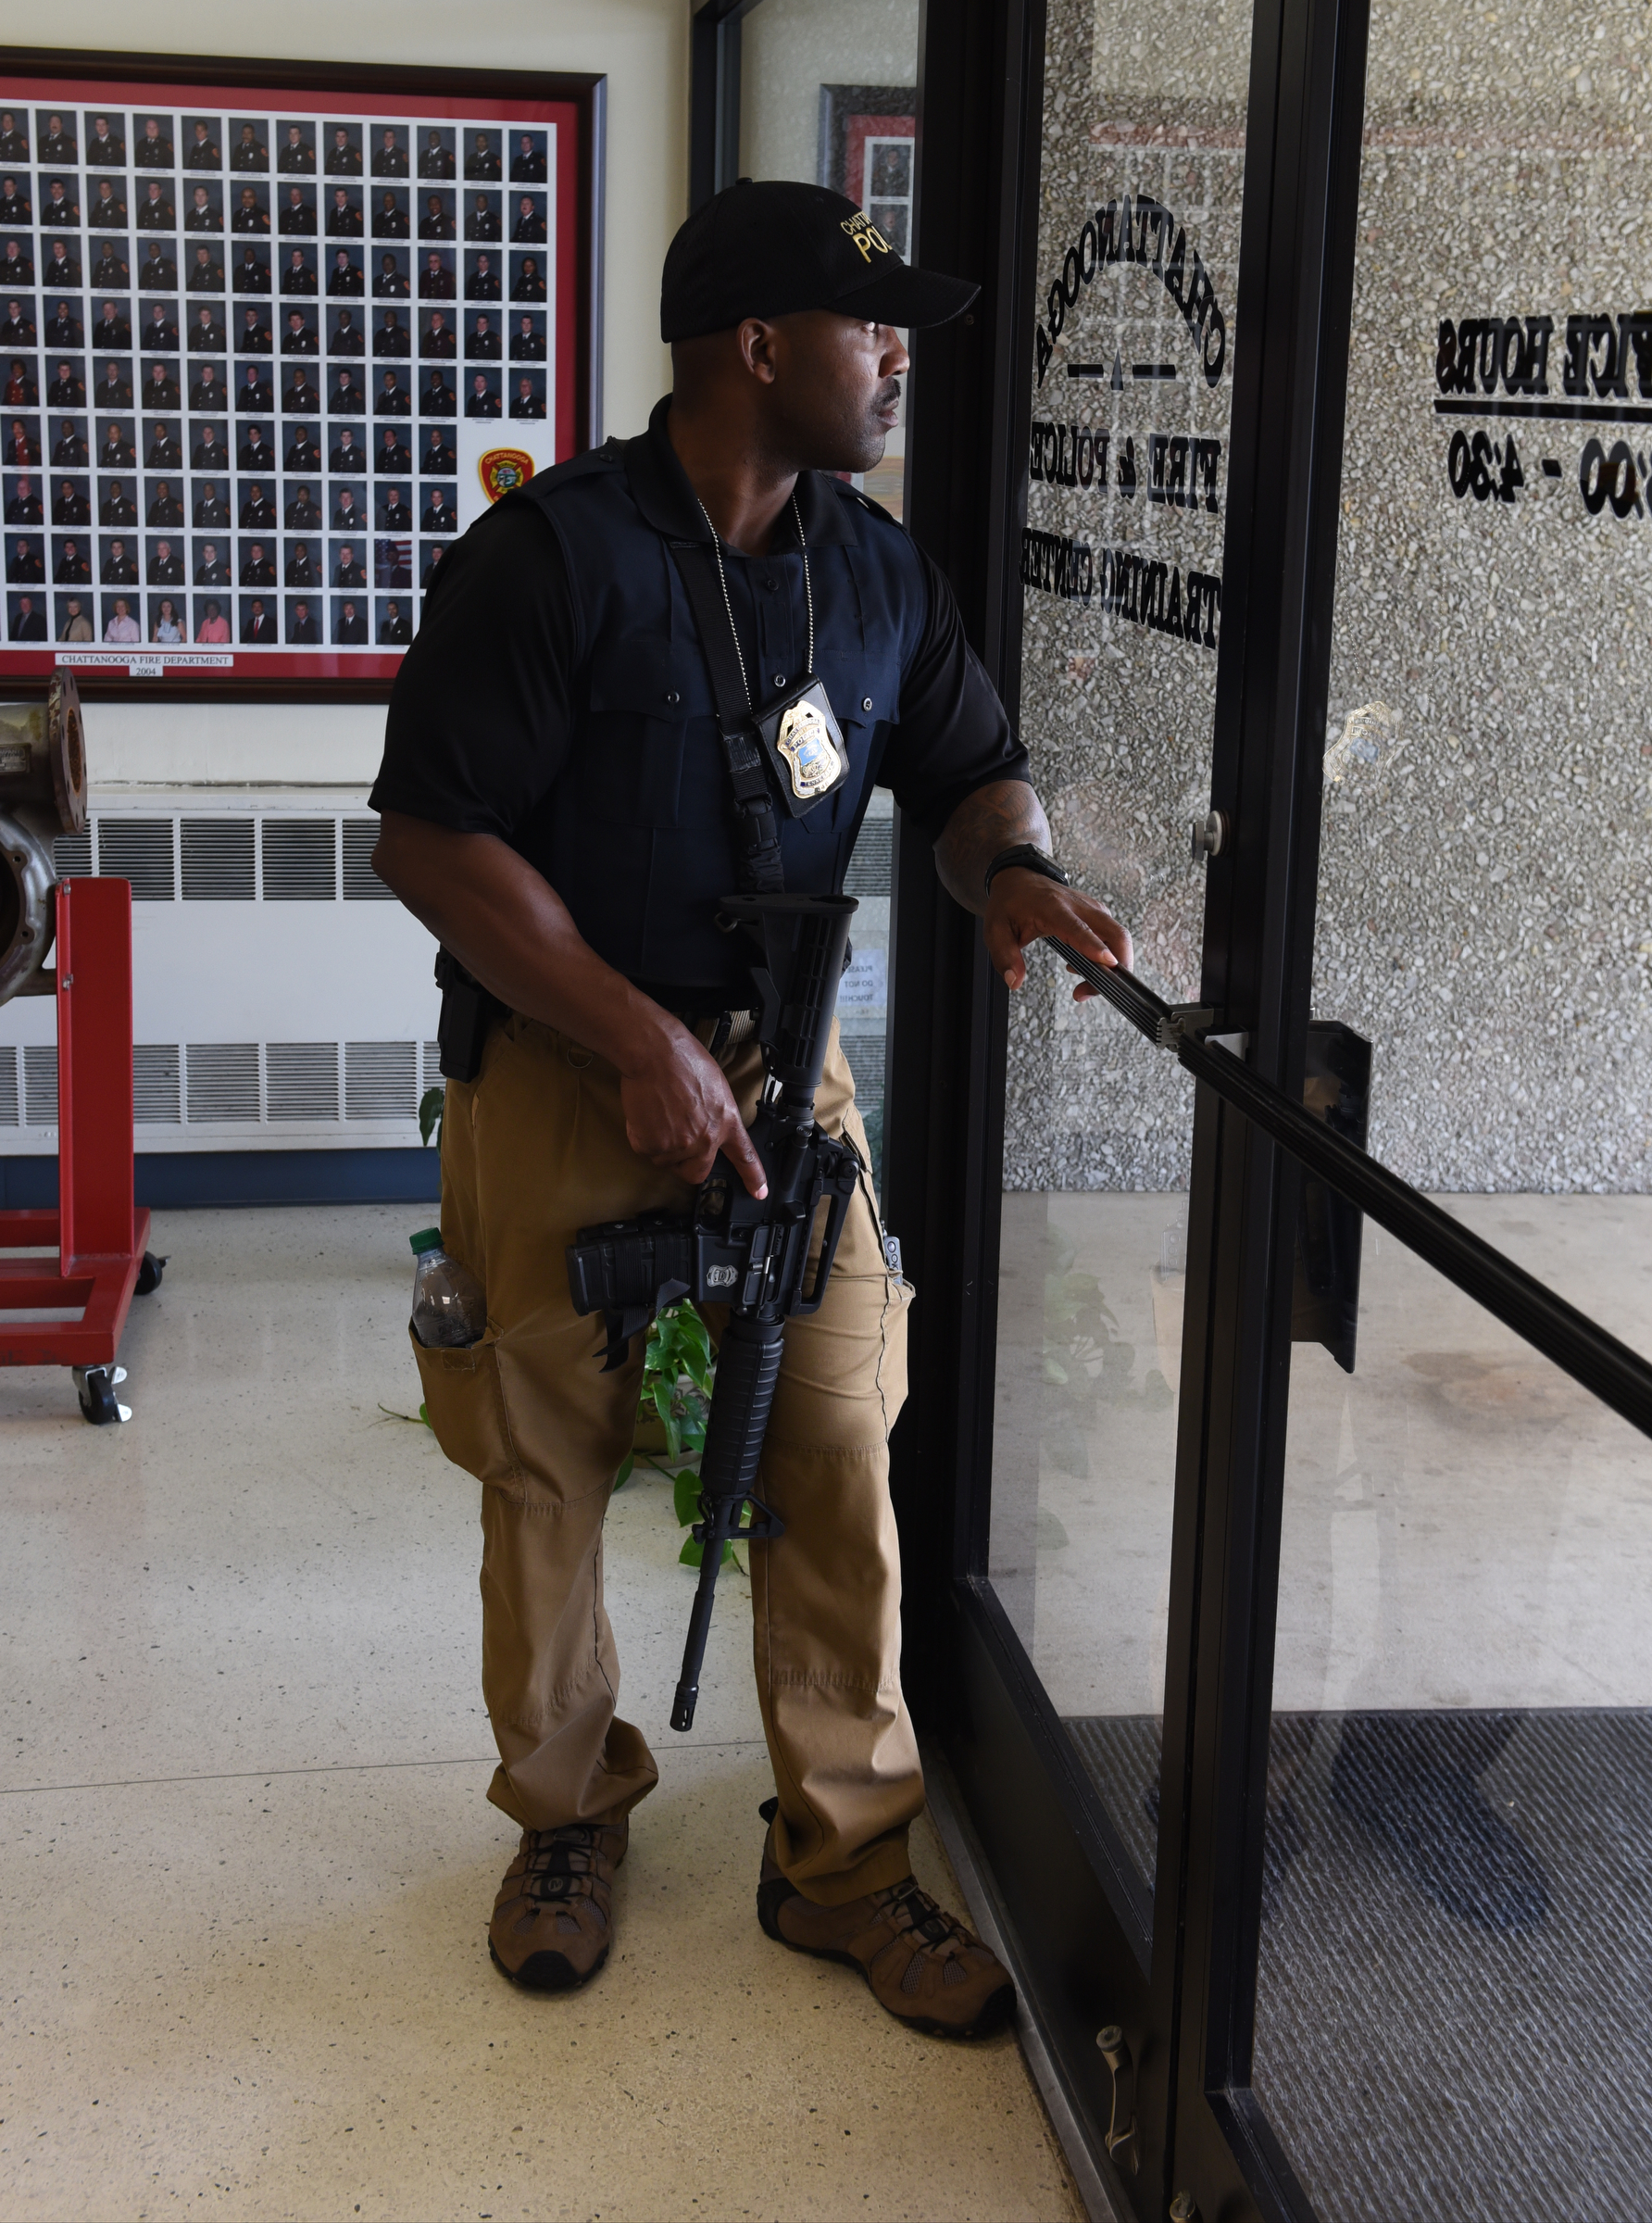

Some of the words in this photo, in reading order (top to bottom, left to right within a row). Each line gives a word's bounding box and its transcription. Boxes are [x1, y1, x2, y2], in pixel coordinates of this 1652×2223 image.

[62, 655, 137, 665] CHATTANOOGA
[139, 656, 161, 665] FIRE
[163, 656, 229, 665] DEPARTMENT
[136, 667, 156, 676] 2004
